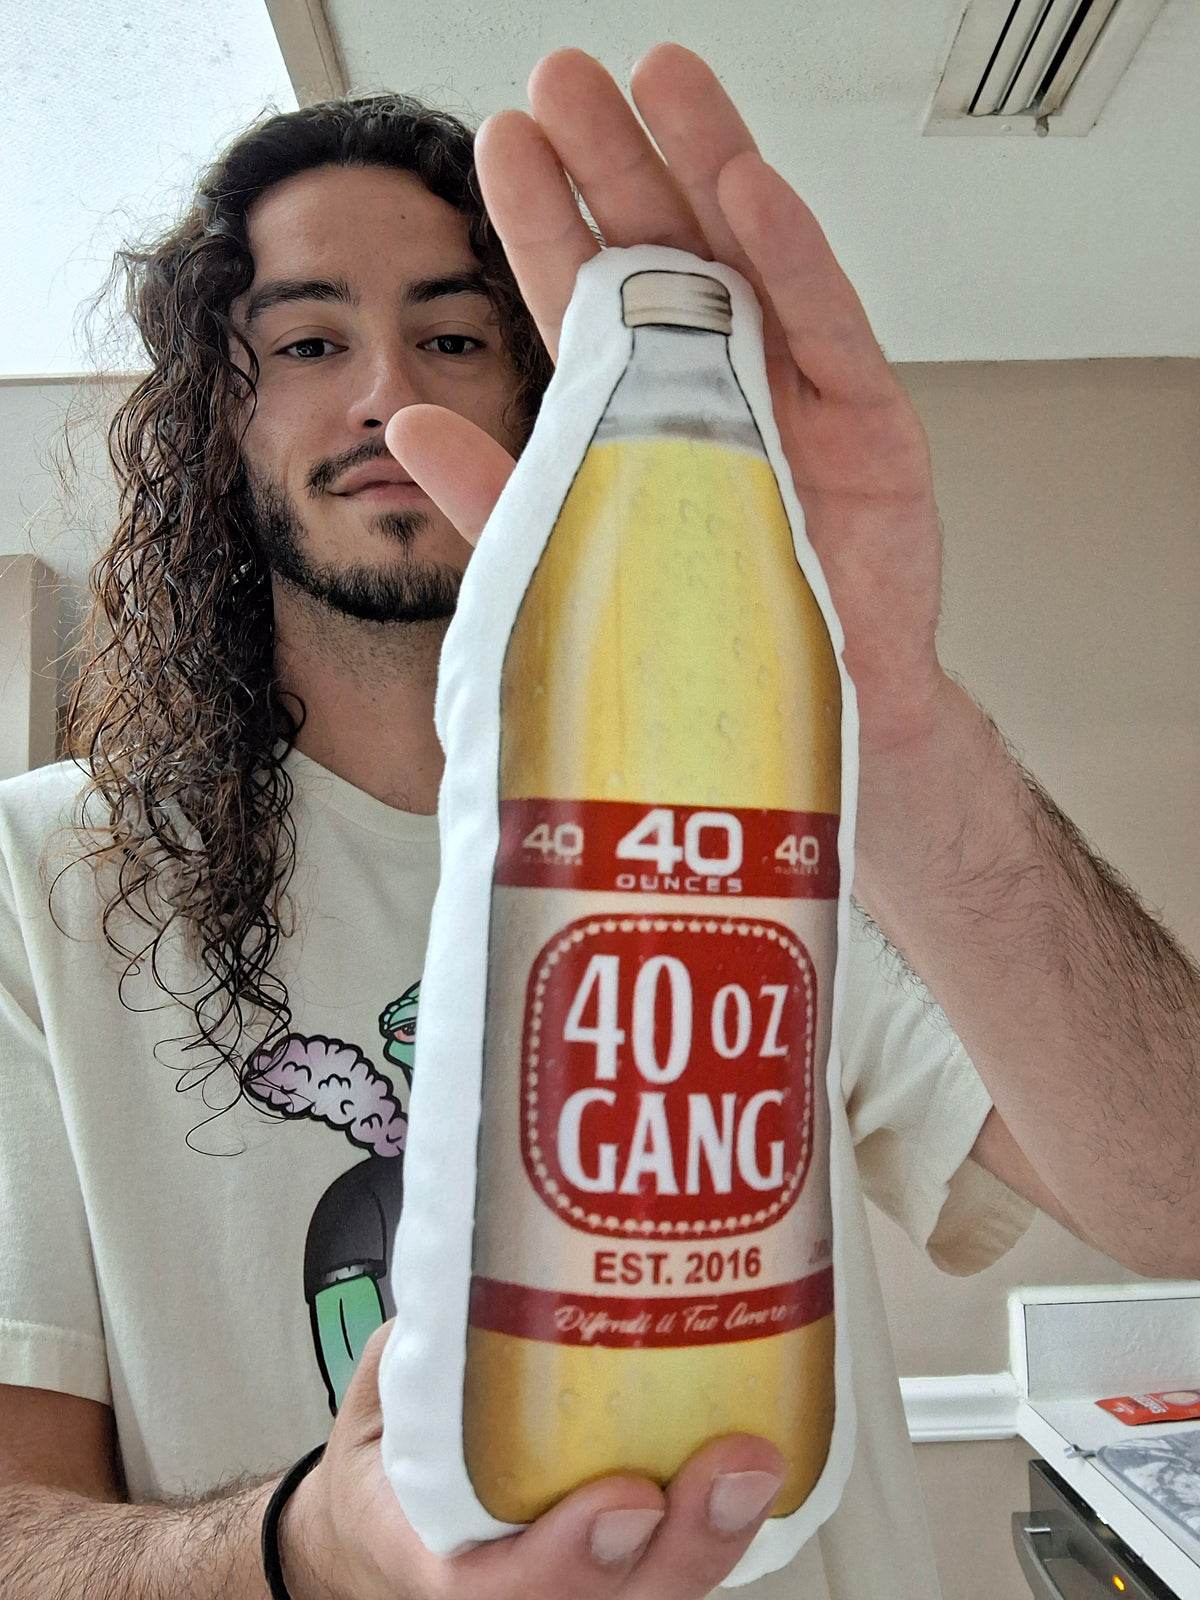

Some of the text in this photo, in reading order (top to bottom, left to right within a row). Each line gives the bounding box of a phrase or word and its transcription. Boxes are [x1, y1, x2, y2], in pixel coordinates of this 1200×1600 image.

[522, 822, 585, 858] 40
[615, 808, 744, 876] 40
[774, 834, 820, 867] 40
[616, 872, 744, 894] OUNCES
[563, 953, 790, 1085] 40 OZ
[556, 1086, 786, 1197] GANG
[593, 1249, 673, 1286] EST.
[685, 1246, 762, 1285] 2016
